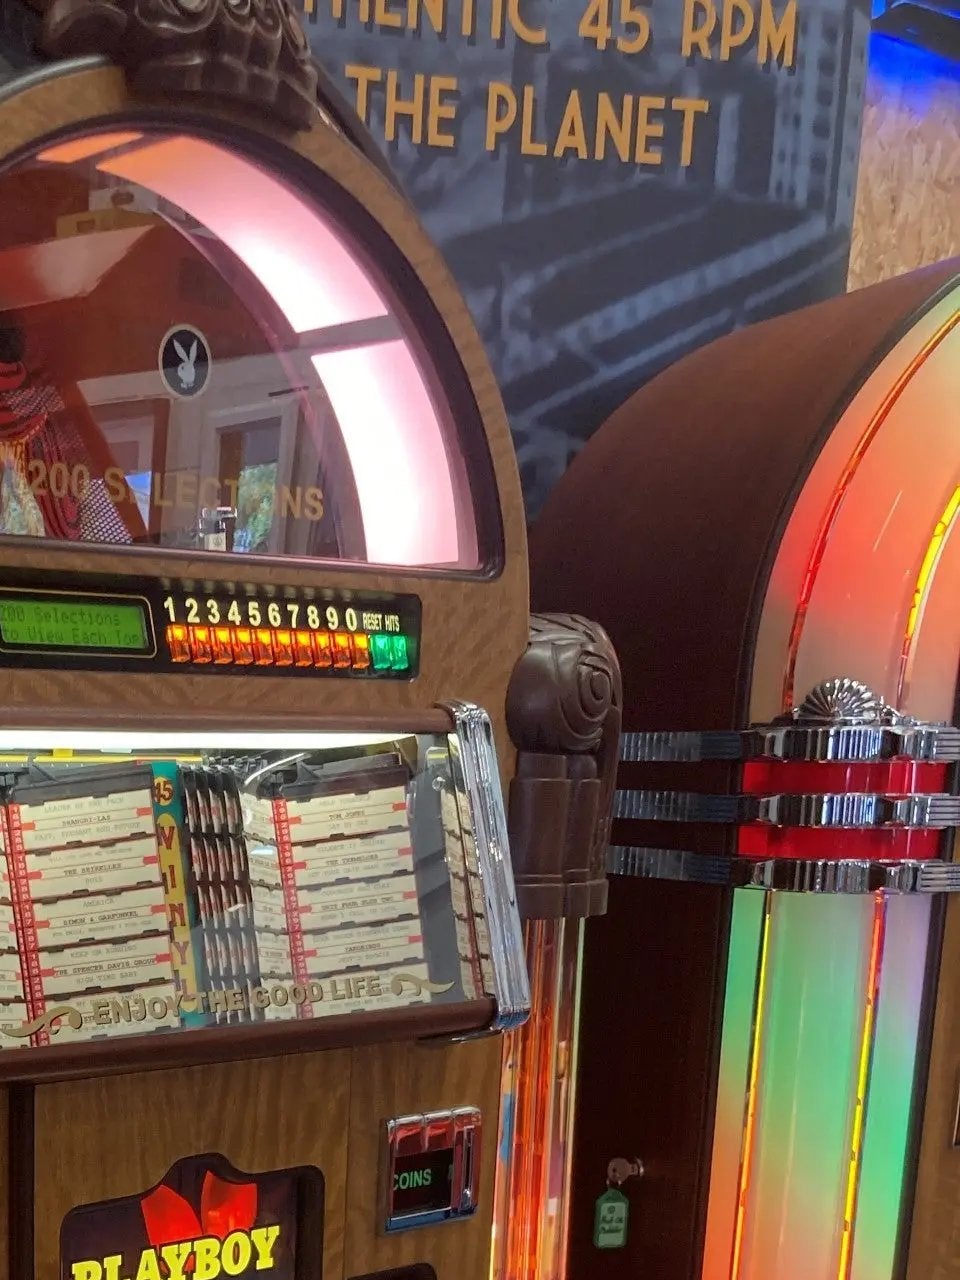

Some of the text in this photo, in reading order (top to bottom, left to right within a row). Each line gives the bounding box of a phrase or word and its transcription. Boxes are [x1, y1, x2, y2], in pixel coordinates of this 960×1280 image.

[578, 0, 651, 54] 45
[681, 0, 797, 67] RPM
[345, 64, 709, 167] THE PLANET
[28, 459, 90, 499] 200
[163, 596, 400, 632] 1 2 3 4 5 6 7 8 9 0 RESET HITS
[71, 629, 106, 645] Each
[93, 994, 183, 1025] ENJOY
[197, 988, 245, 1014] THE
[251, 981, 323, 1009] GOOD
[330, 975, 382, 1001] LIFE
